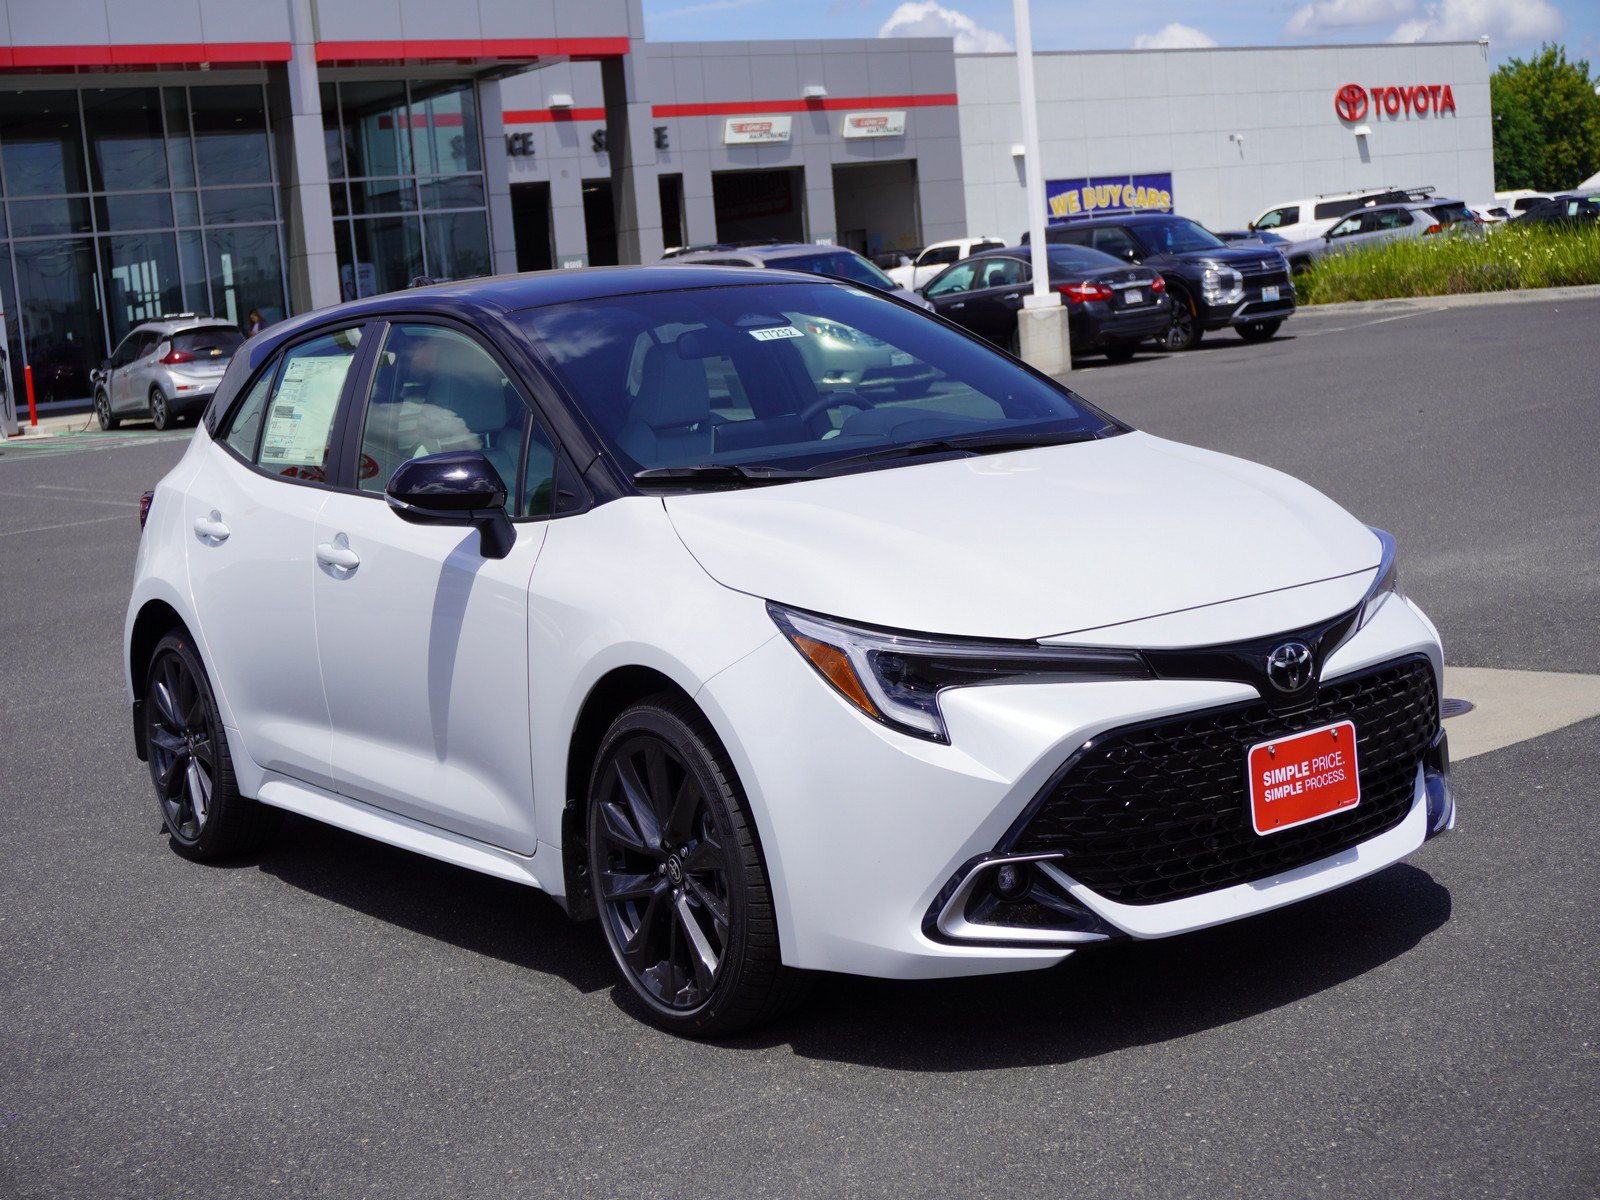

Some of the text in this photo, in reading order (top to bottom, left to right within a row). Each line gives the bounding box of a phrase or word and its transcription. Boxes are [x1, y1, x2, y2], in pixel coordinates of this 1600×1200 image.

[1370, 85, 1456, 115] TOYOTA
[1049, 184, 1171, 216] WE BUY CARS
[1263, 750, 1346, 786] SIMPLE PRICE.
[1264, 768, 1347, 803] SIMPLE PROCESS.
